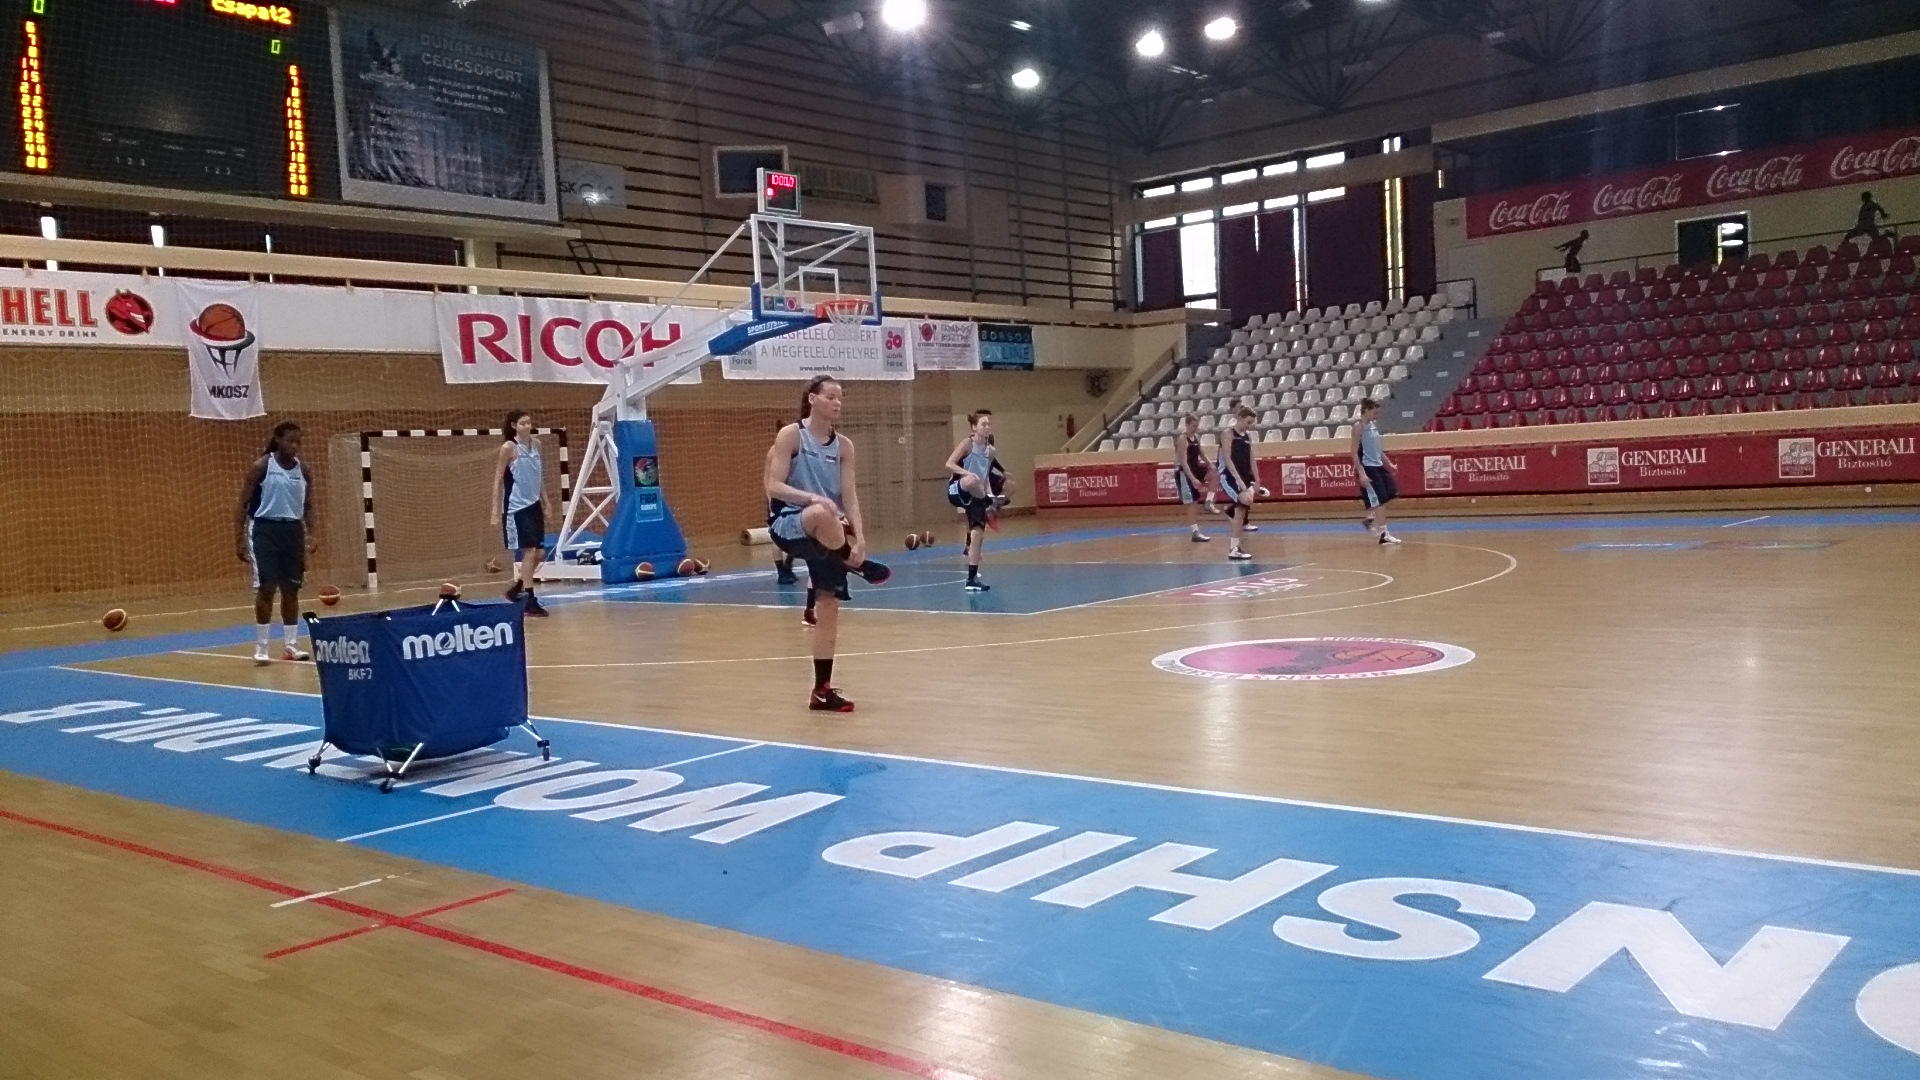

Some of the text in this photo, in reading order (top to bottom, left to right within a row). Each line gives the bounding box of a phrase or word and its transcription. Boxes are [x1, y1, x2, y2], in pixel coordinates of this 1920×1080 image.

[1706, 153, 1805, 198] Coca-Cola
[1592, 173, 1684, 215] Coca-Cola
[1488, 190, 1572, 231] Coca-Cola
[1, 286, 98, 328] HELL
[2, 328, 98, 338] ENERGY DRINK
[457, 313, 681, 368] RICOH
[760, 343, 879, 360] A MEGFELELŐ HELYRE!
[1621, 447, 1707, 466] GENERALI
[1817, 437, 1915, 458] GENERALI
[1453, 455, 1526, 472] GENERALI
[1838, 457, 1892, 469] Biztosító
[1068, 475, 1118, 489] GENERALI
[315, 635, 371, 664] molten
[402, 622, 514, 660] molten
[0, 700, 147, 723] B
